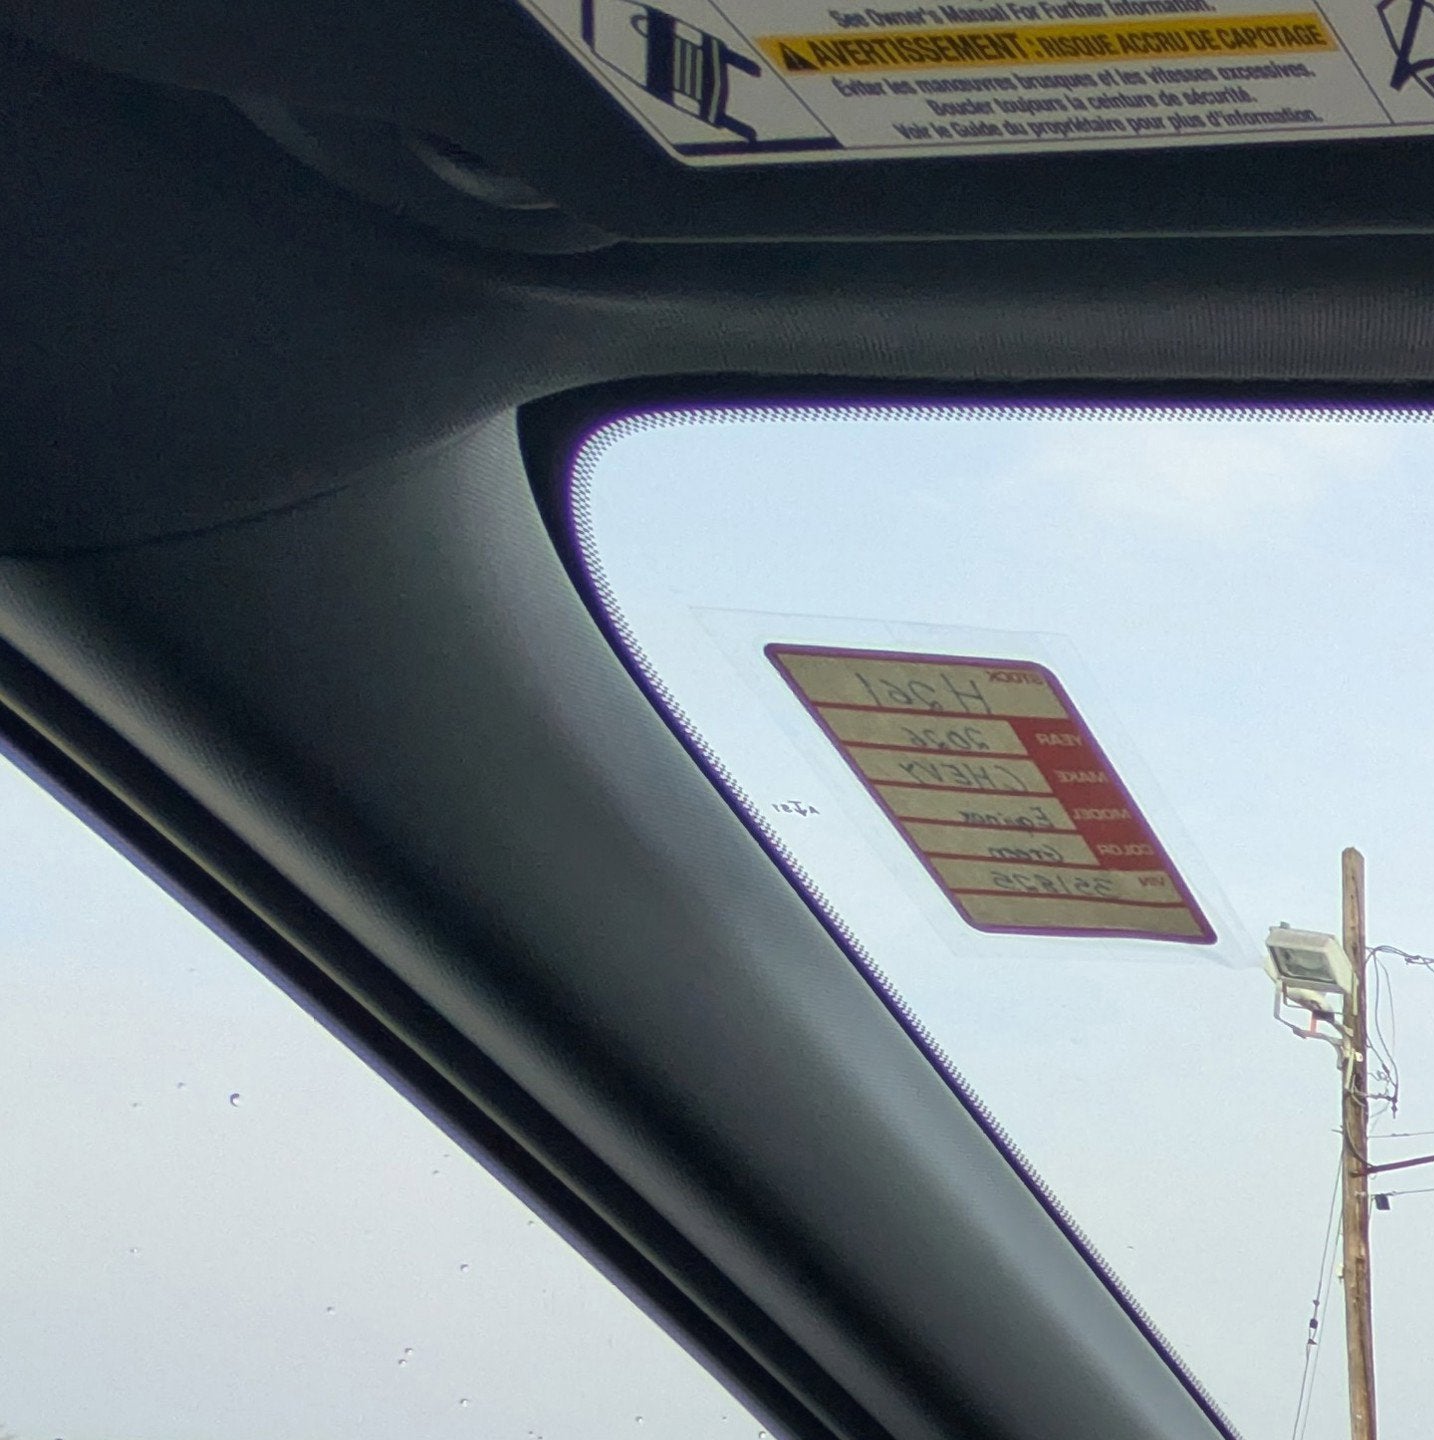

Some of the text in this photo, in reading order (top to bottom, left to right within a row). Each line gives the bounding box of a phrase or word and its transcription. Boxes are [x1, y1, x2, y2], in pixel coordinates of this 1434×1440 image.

[829, 9, 869, 28] See
[866, 7, 943, 27] Owner's
[940, 3, 1011, 24] Manual
[1009, 2, 1041, 20] For
[1041, 0, 1105, 19] Further
[807, 24, 1328, 67] AVERTISSEMENT RISQUE ACCRU DE CAPOTAGE
[883, 78, 917, 95] les
[1012, 71, 1098, 91] brusques
[1098, 69, 1118, 87] et
[1115, 68, 1147, 86] les
[1145, 66, 1218, 85] vitesses
[1217, 60, 1316, 82] excessives.
[926, 99, 995, 117] Boucler
[994, 96, 1068, 116] toujours
[1064, 94, 1088, 111] la
[1087, 92, 1159, 110] ceinture
[1159, 90, 1183, 107] de
[893, 122, 930, 140] Voir
[930, 121, 953, 139] le
[950, 120, 1003, 137] Guide
[1002, 119, 1026, 136] du
[1126, 115, 1167, 134] pour
[1167, 112, 1209, 133] plus
